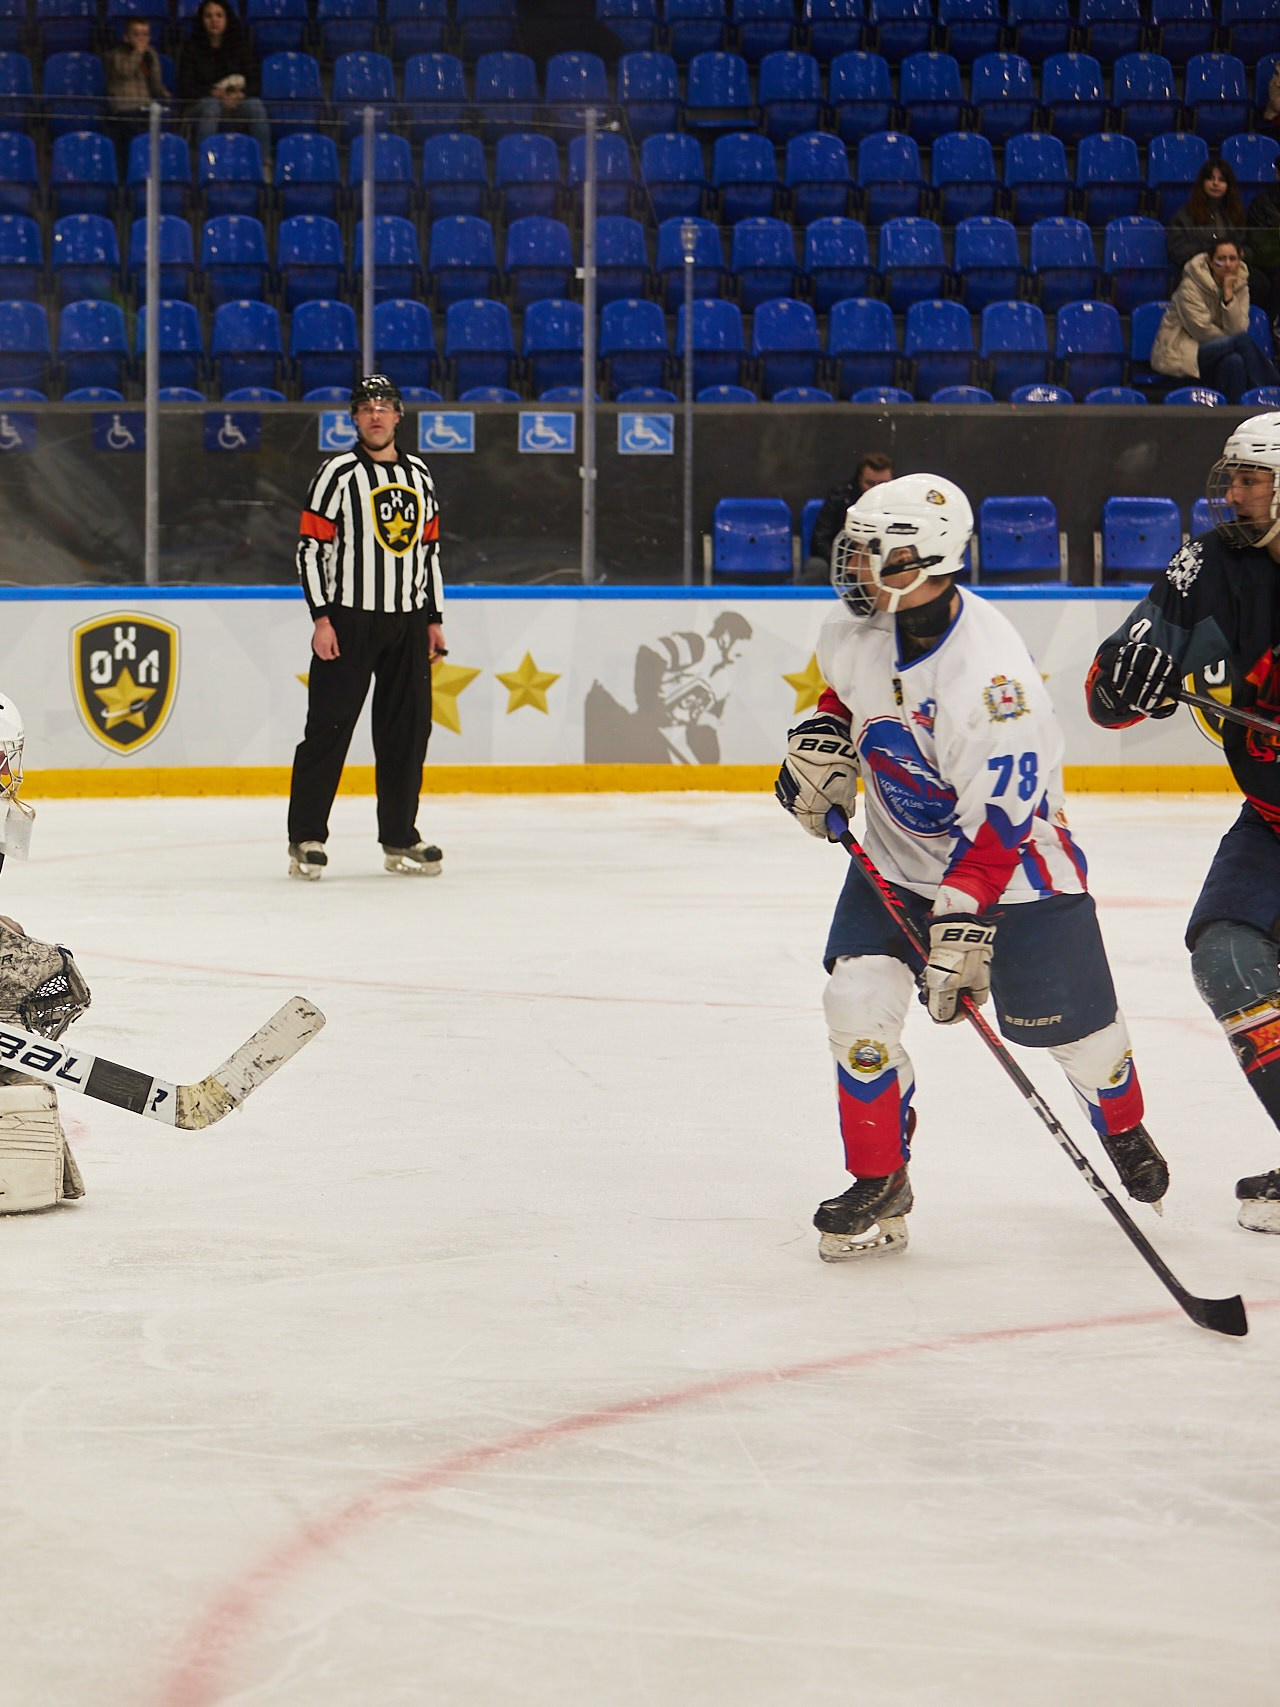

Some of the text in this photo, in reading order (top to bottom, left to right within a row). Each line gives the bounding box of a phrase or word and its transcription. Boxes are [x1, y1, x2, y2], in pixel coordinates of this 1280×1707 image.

[797, 738, 860, 764] BAU
[987, 751, 1038, 802] 78
[1004, 1014, 1063, 1027] BAUER
